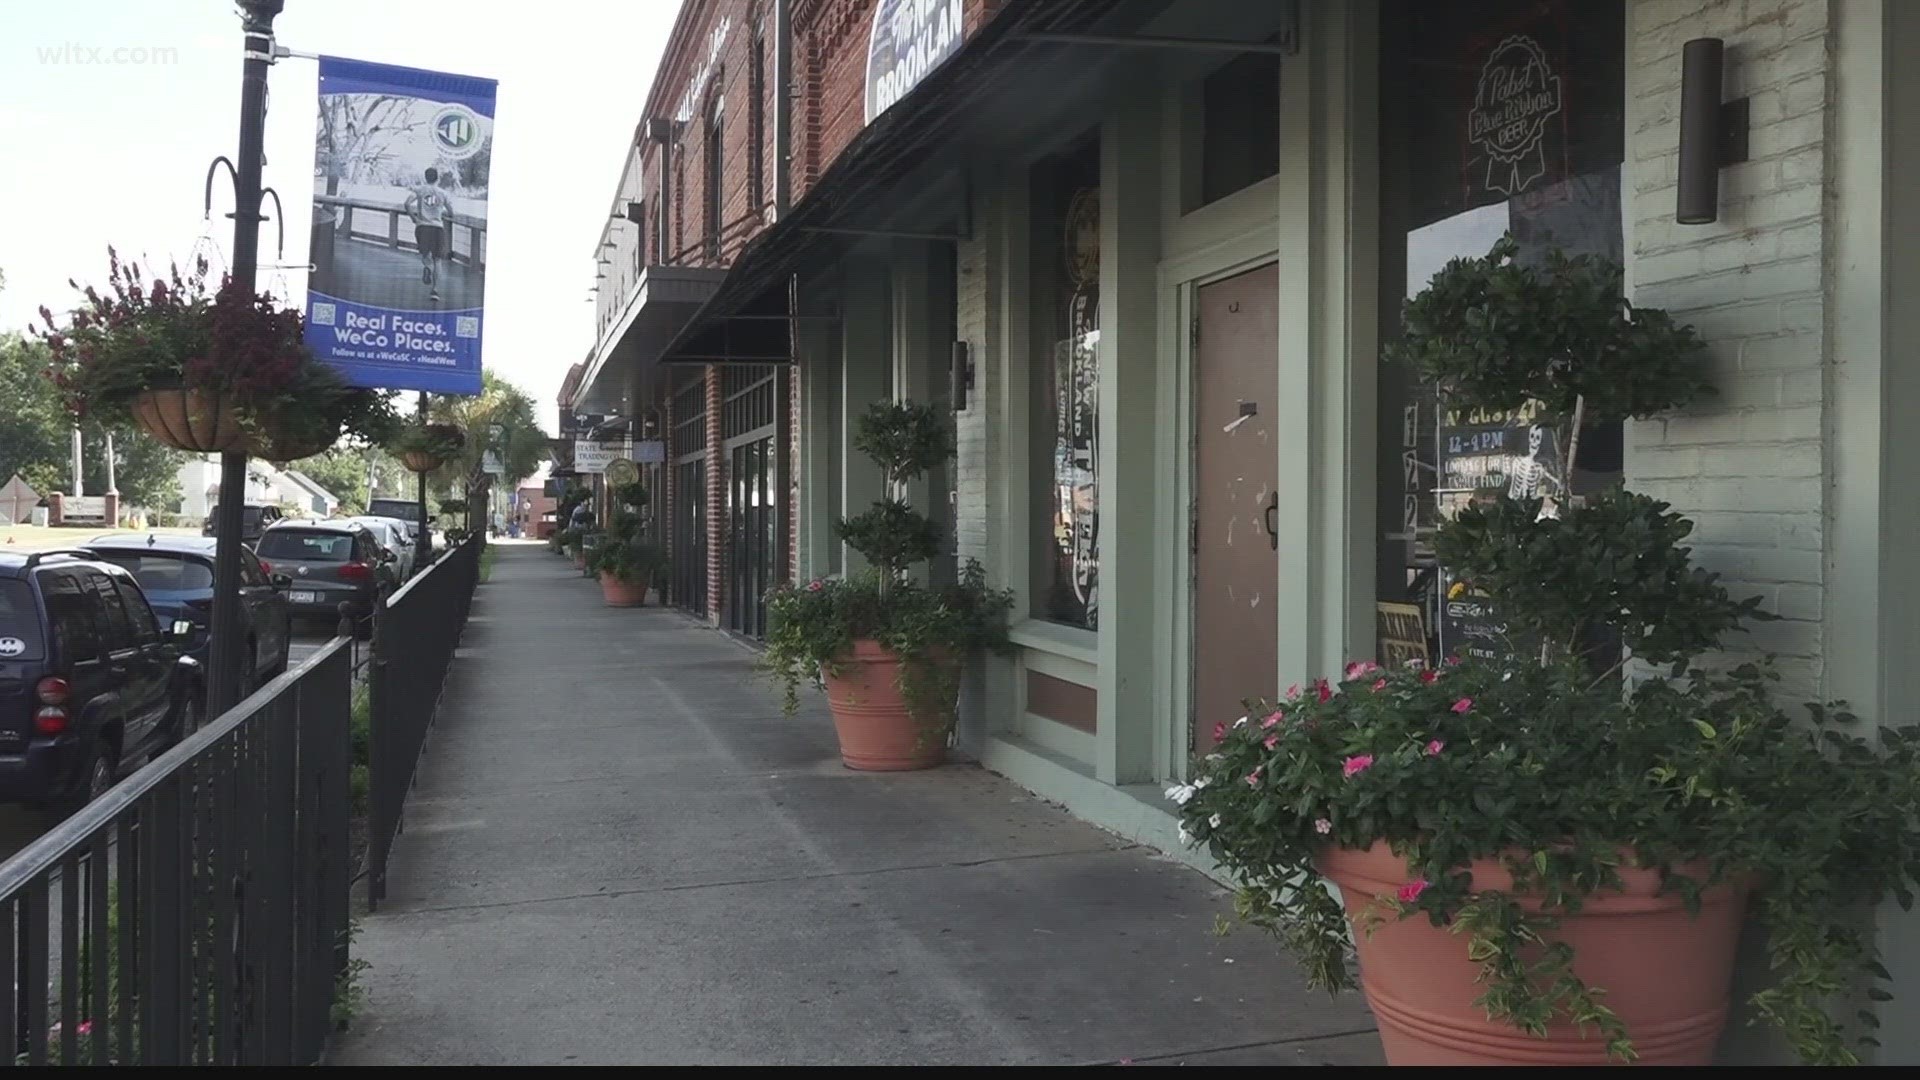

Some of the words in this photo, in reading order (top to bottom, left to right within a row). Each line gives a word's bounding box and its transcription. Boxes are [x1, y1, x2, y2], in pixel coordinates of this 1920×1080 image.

[1490, 55, 1537, 106] Pabst
[1474, 112, 1502, 136] Blue
[1505, 91, 1555, 121] Ribbon
[1498, 119, 1529, 145] BEER
[346, 311, 386, 330] Real
[392, 316, 447, 336] Faces.
[332, 347, 355, 357] Follow
[334, 327, 388, 347] WeCo
[395, 333, 455, 353] Places.
